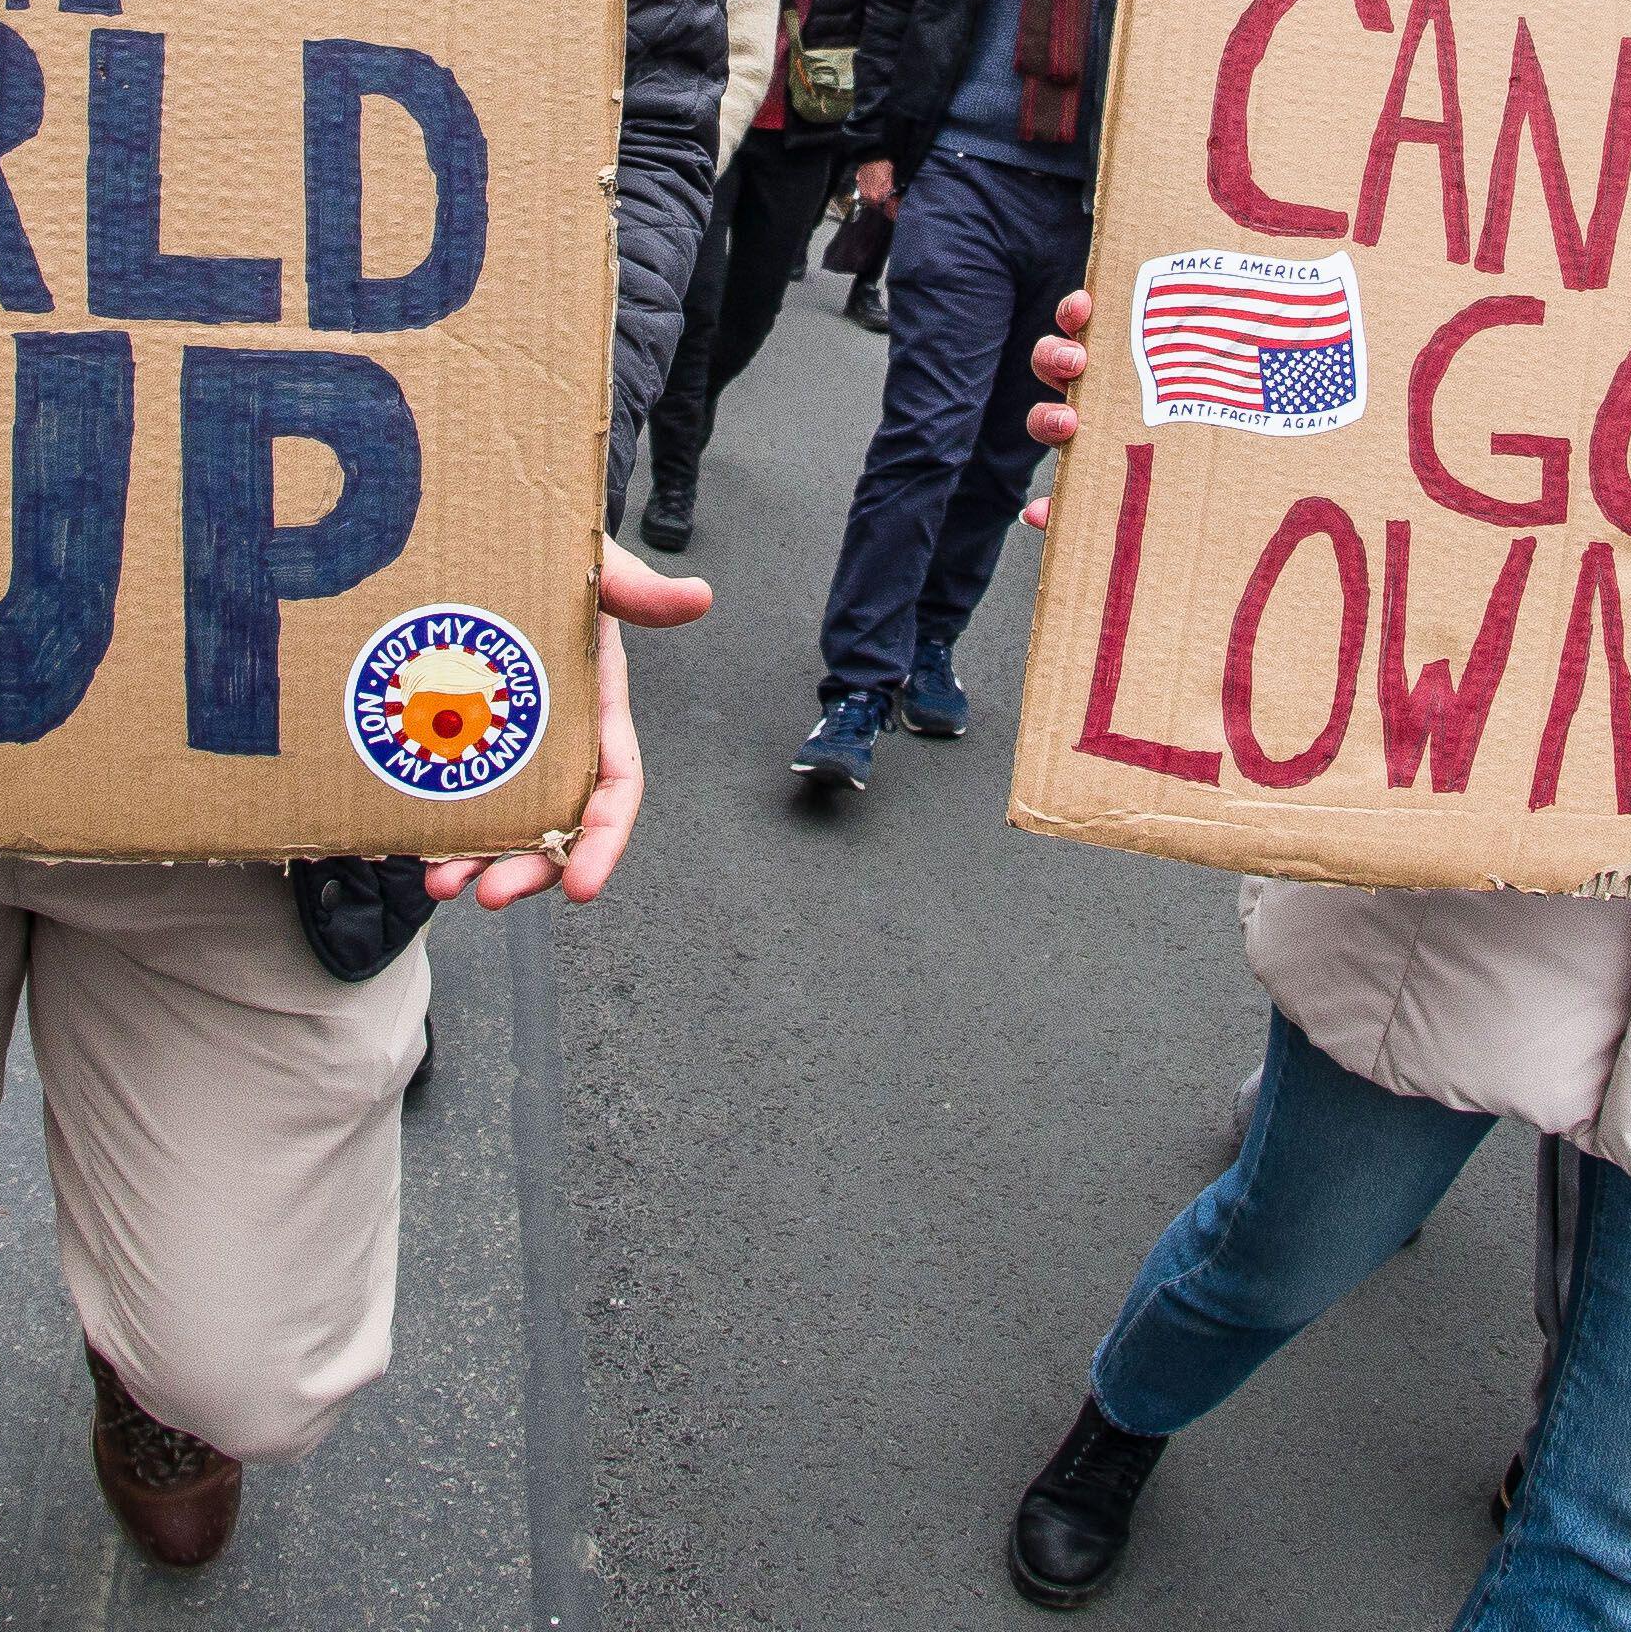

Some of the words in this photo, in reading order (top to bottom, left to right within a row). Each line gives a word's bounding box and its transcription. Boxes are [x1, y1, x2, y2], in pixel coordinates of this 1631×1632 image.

[1170, 256, 1224, 272] MAKE
[1239, 259, 1321, 281] AMERICA
[1168, 403, 1271, 427] ANTI-FACIST
[1282, 415, 1338, 430] AGAIN
[370, 625, 417, 680] NOT
[427, 617, 475, 645] MY
[475, 628, 537, 708] CIRCUS
[1072, 443, 1537, 794] LOW
[357, 691, 394, 745] NOT
[385, 749, 432, 783] MY
[440, 721, 527, 790] CLOWN
